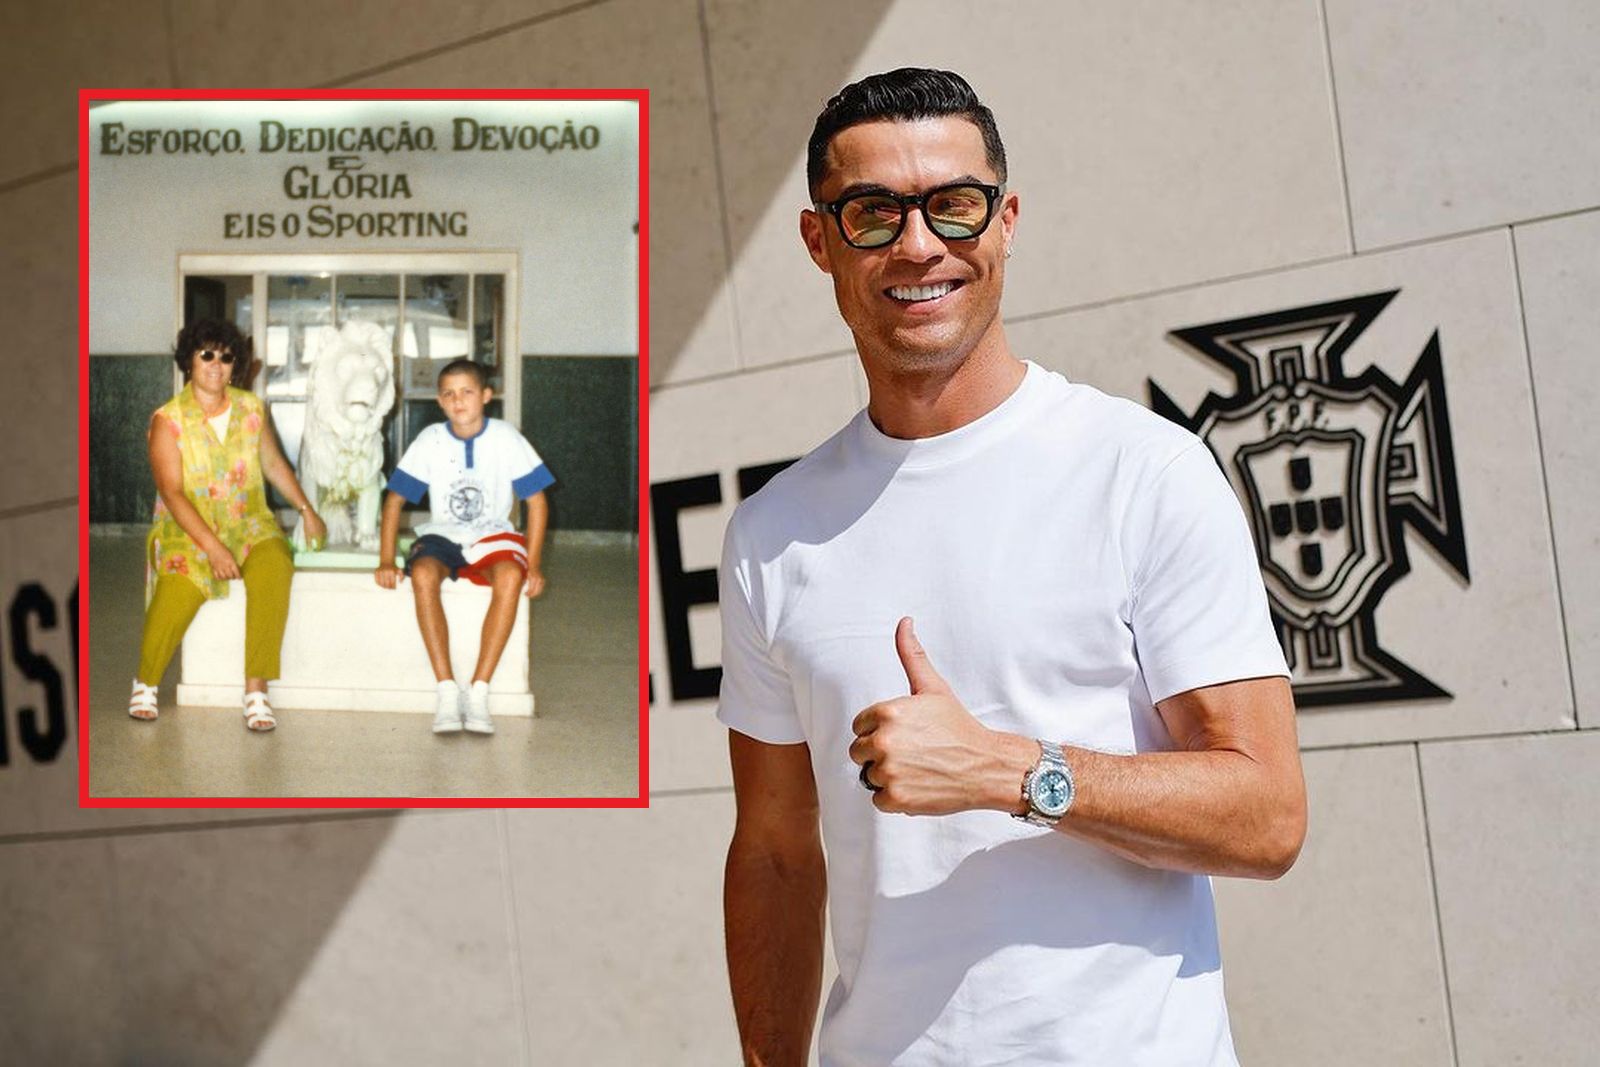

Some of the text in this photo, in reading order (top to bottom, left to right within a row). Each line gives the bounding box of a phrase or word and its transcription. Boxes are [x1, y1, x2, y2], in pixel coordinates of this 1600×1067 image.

[452, 117, 600, 154] DEVOÇÃO
[328, 156, 366, 171] E
[223, 204, 468, 239] EIS O SPORTING
